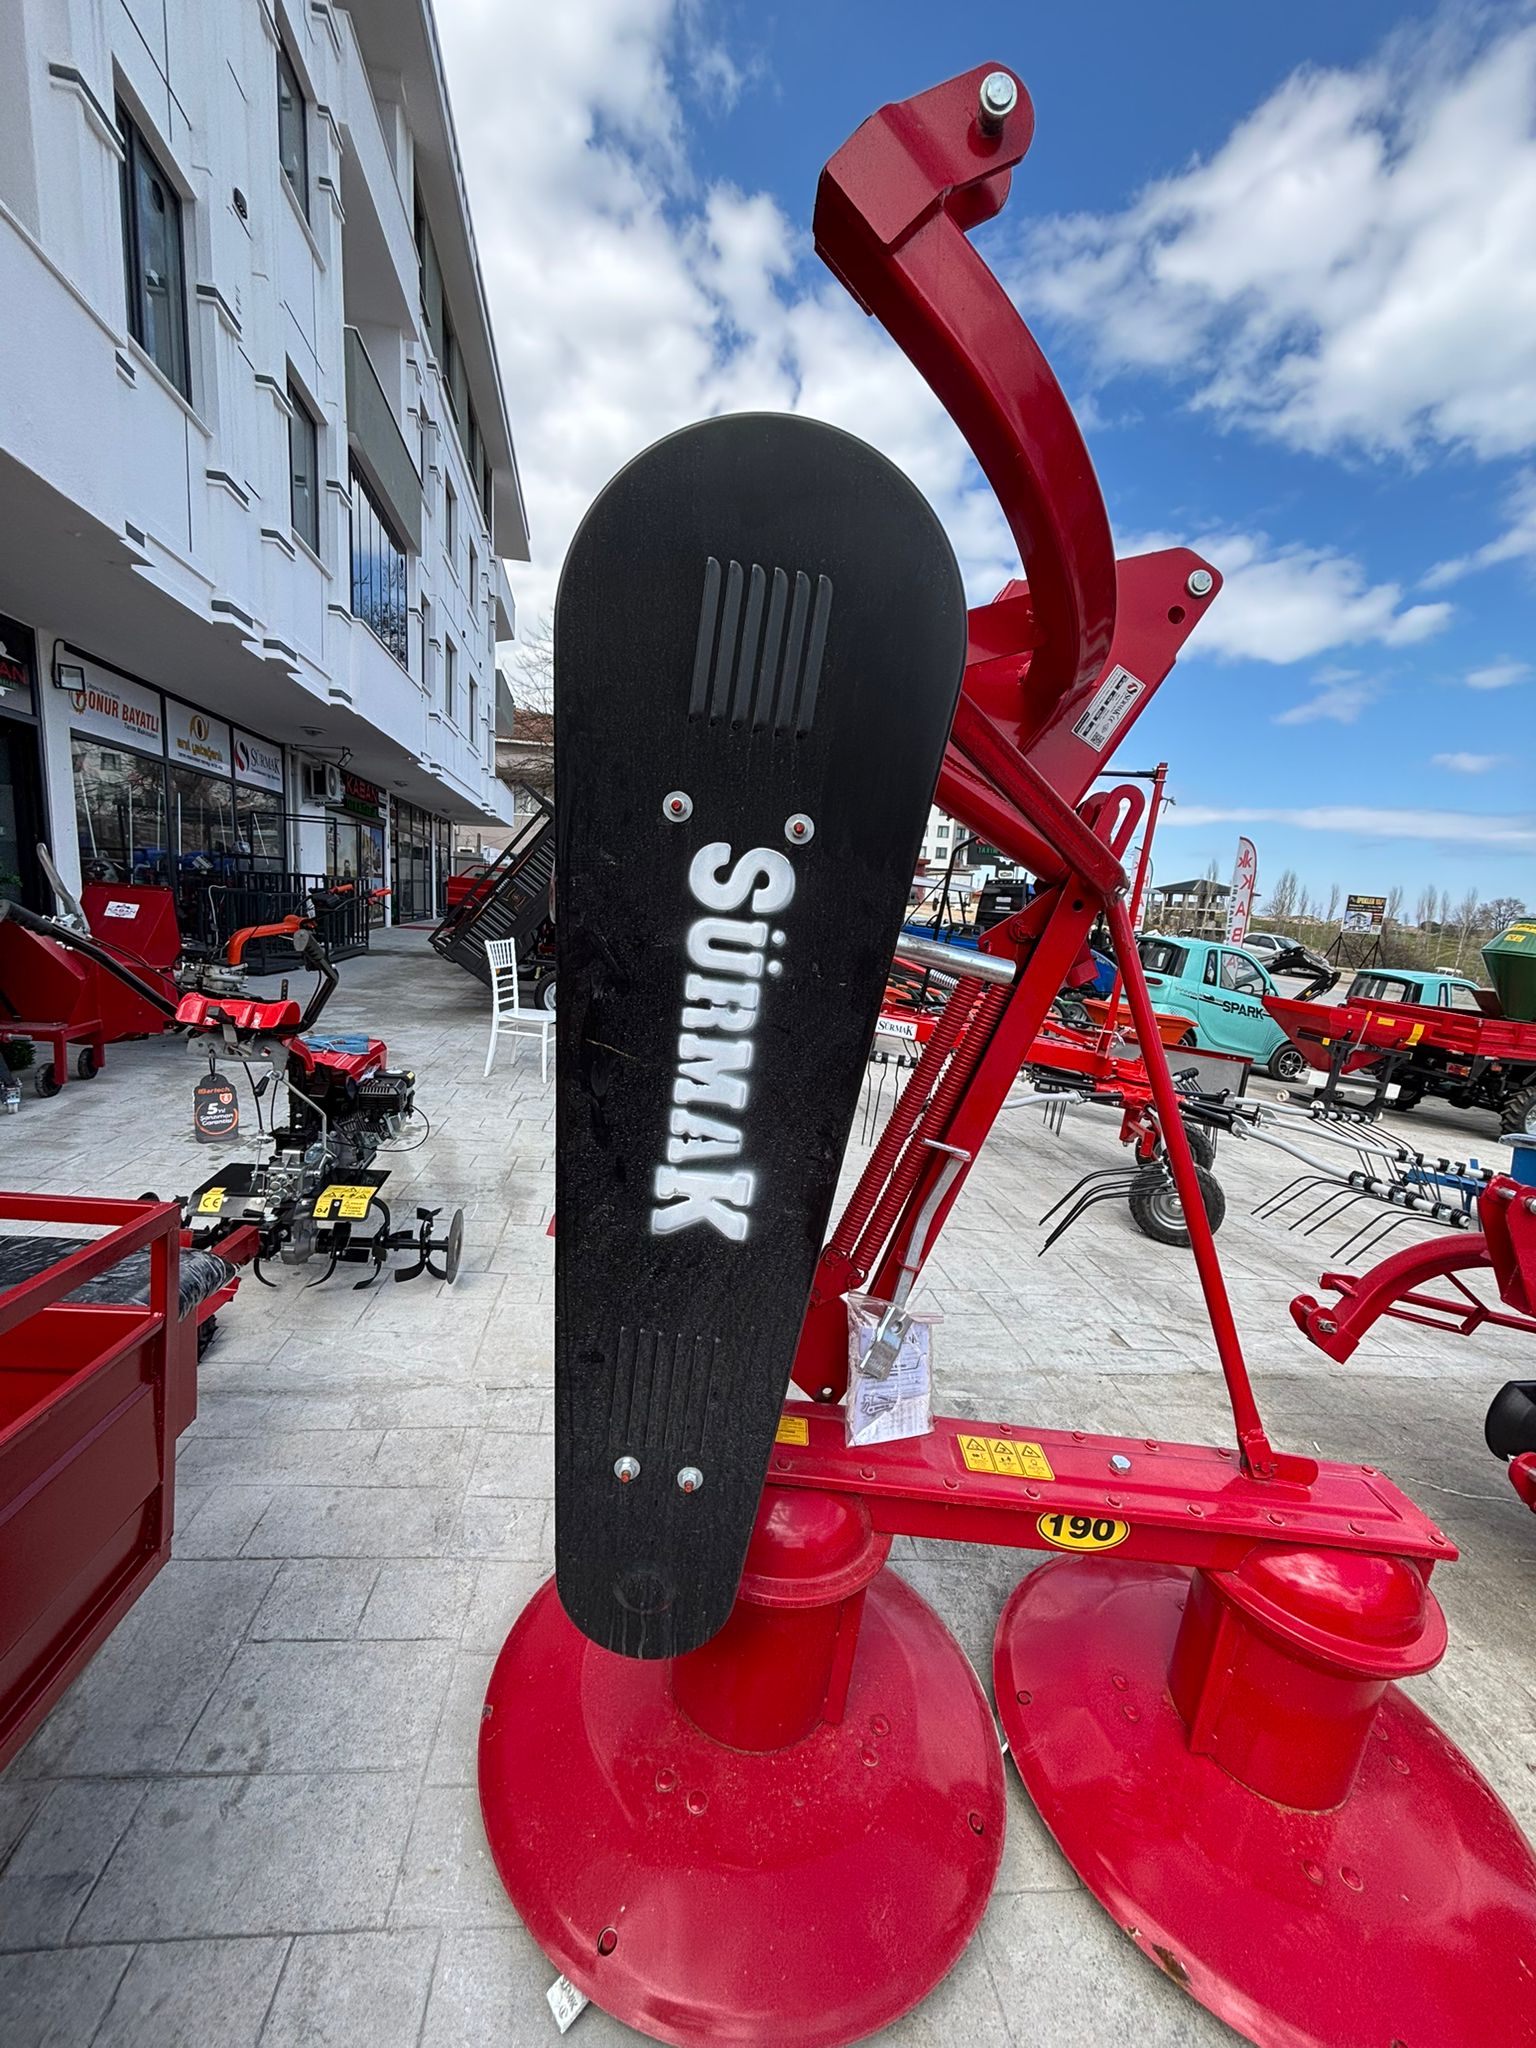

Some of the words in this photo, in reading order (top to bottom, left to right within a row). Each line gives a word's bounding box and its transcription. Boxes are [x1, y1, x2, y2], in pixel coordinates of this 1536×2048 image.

[88, 691, 119, 719] ONUR
[122, 704, 159, 733] BAYATLI
[250, 747, 281, 776] SÜRMAK
[1222, 1000, 1265, 1020] SPARK
[651, 841, 796, 1242] SÜRMAK
[877, 1020, 914, 1037] SÜRMAK
[1049, 1514, 1116, 1542] 190
